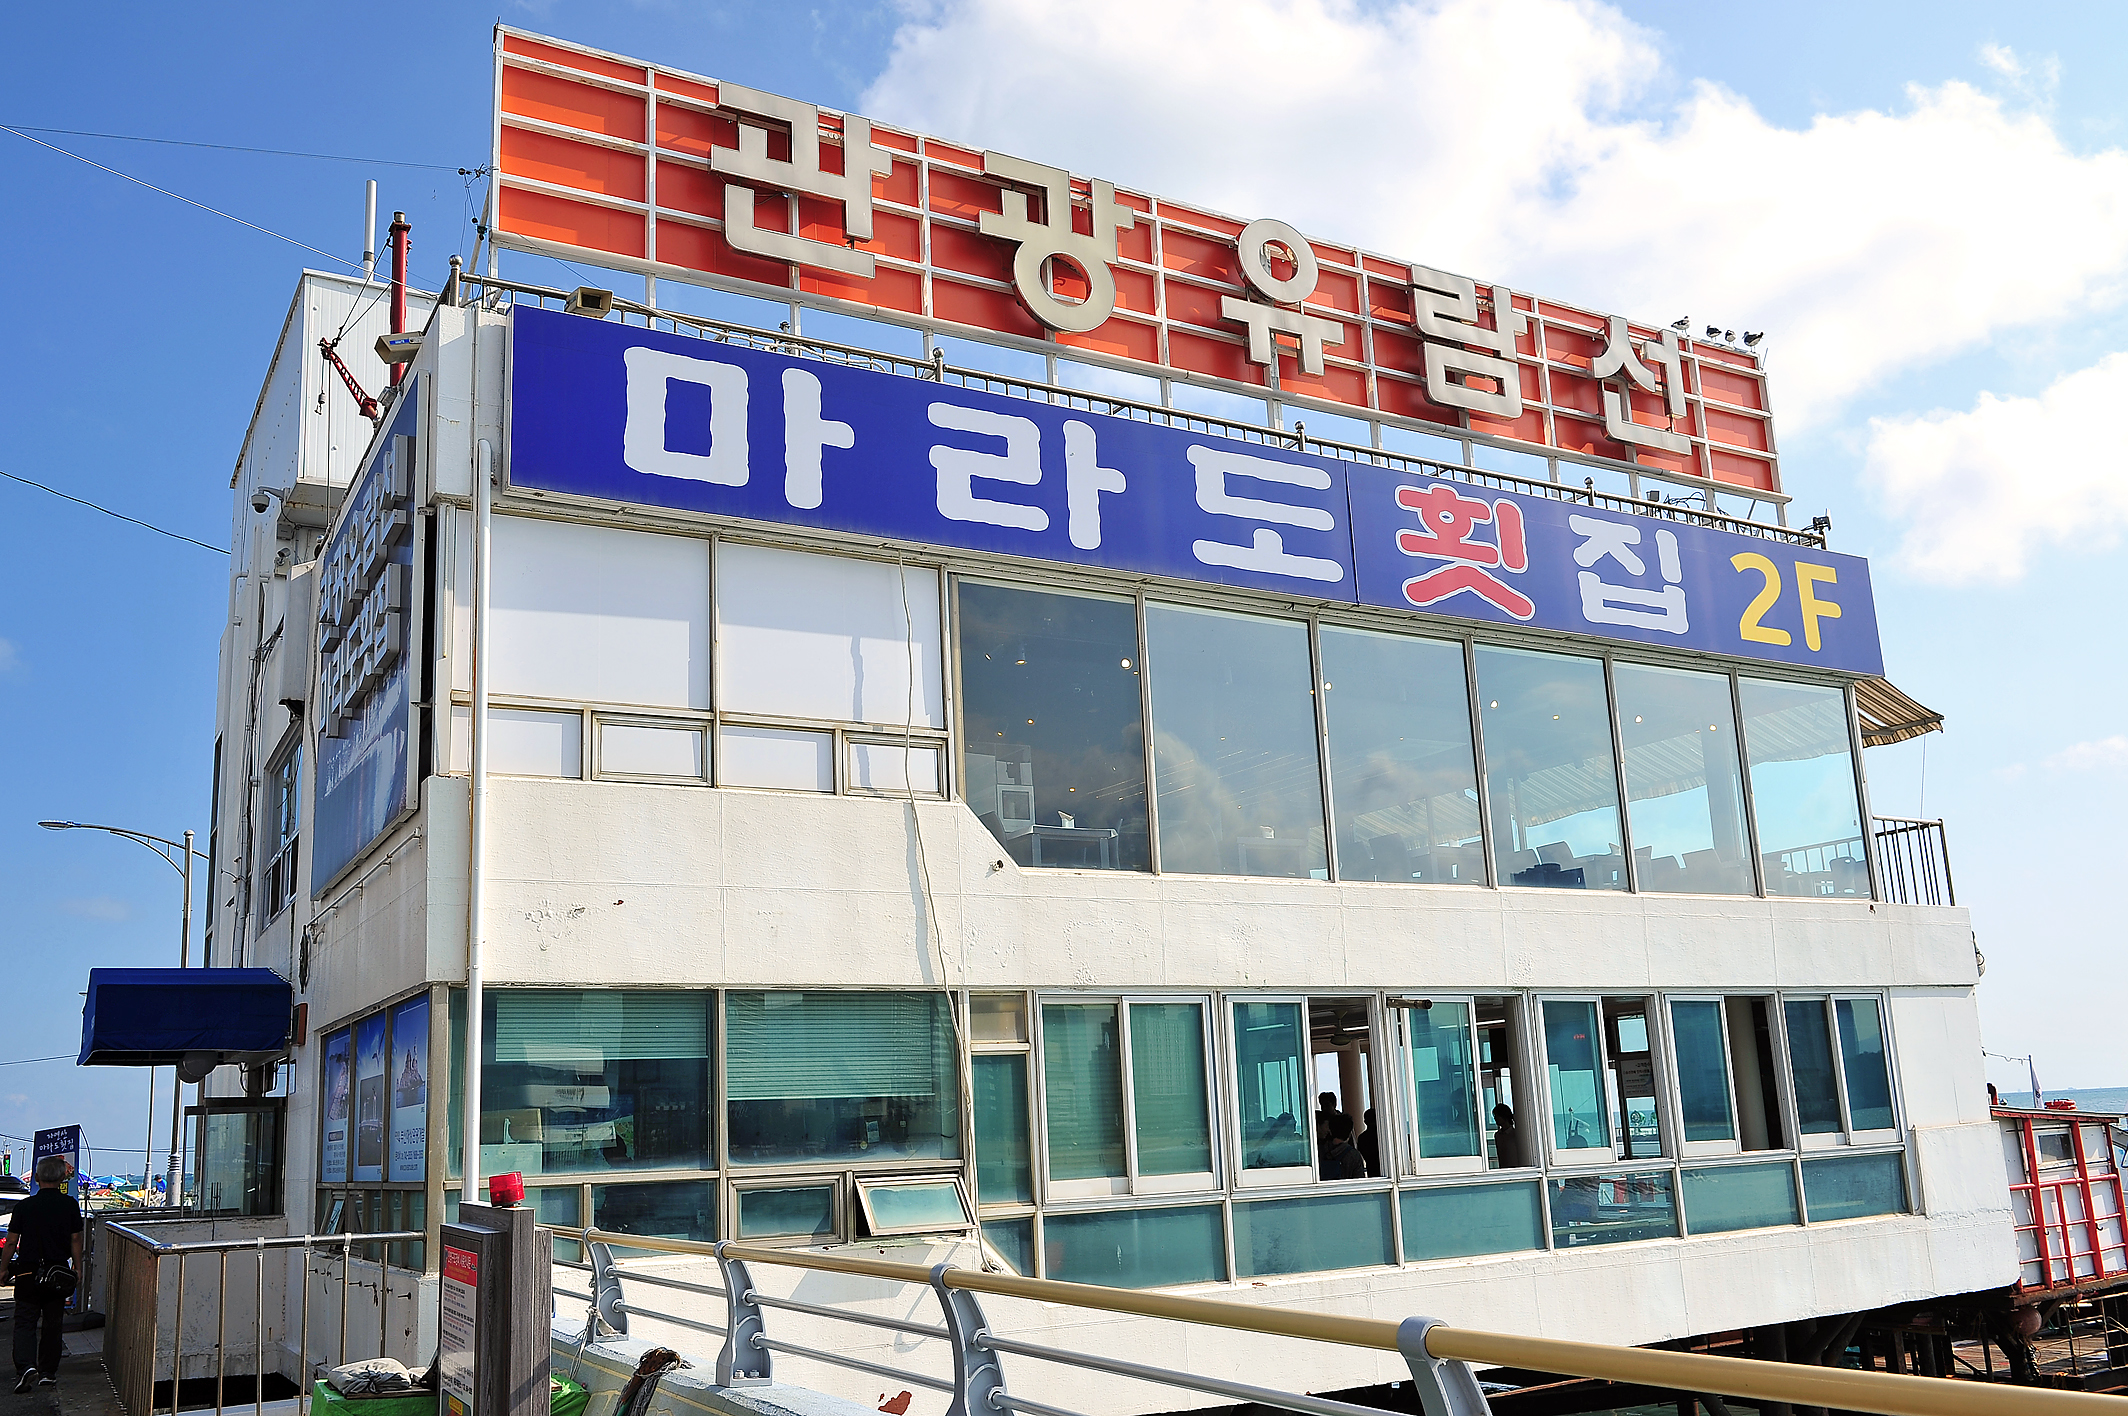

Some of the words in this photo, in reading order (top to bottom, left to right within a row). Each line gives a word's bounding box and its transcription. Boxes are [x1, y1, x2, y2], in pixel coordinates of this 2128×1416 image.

[710, 80, 1692, 457] 관광유람선
[319, 433, 406, 654] 관광유람선
[623, 346, 1690, 636] 마라도횟집
[1729, 552, 1843, 653] 2F
[319, 562, 402, 738] 마라도횟집
